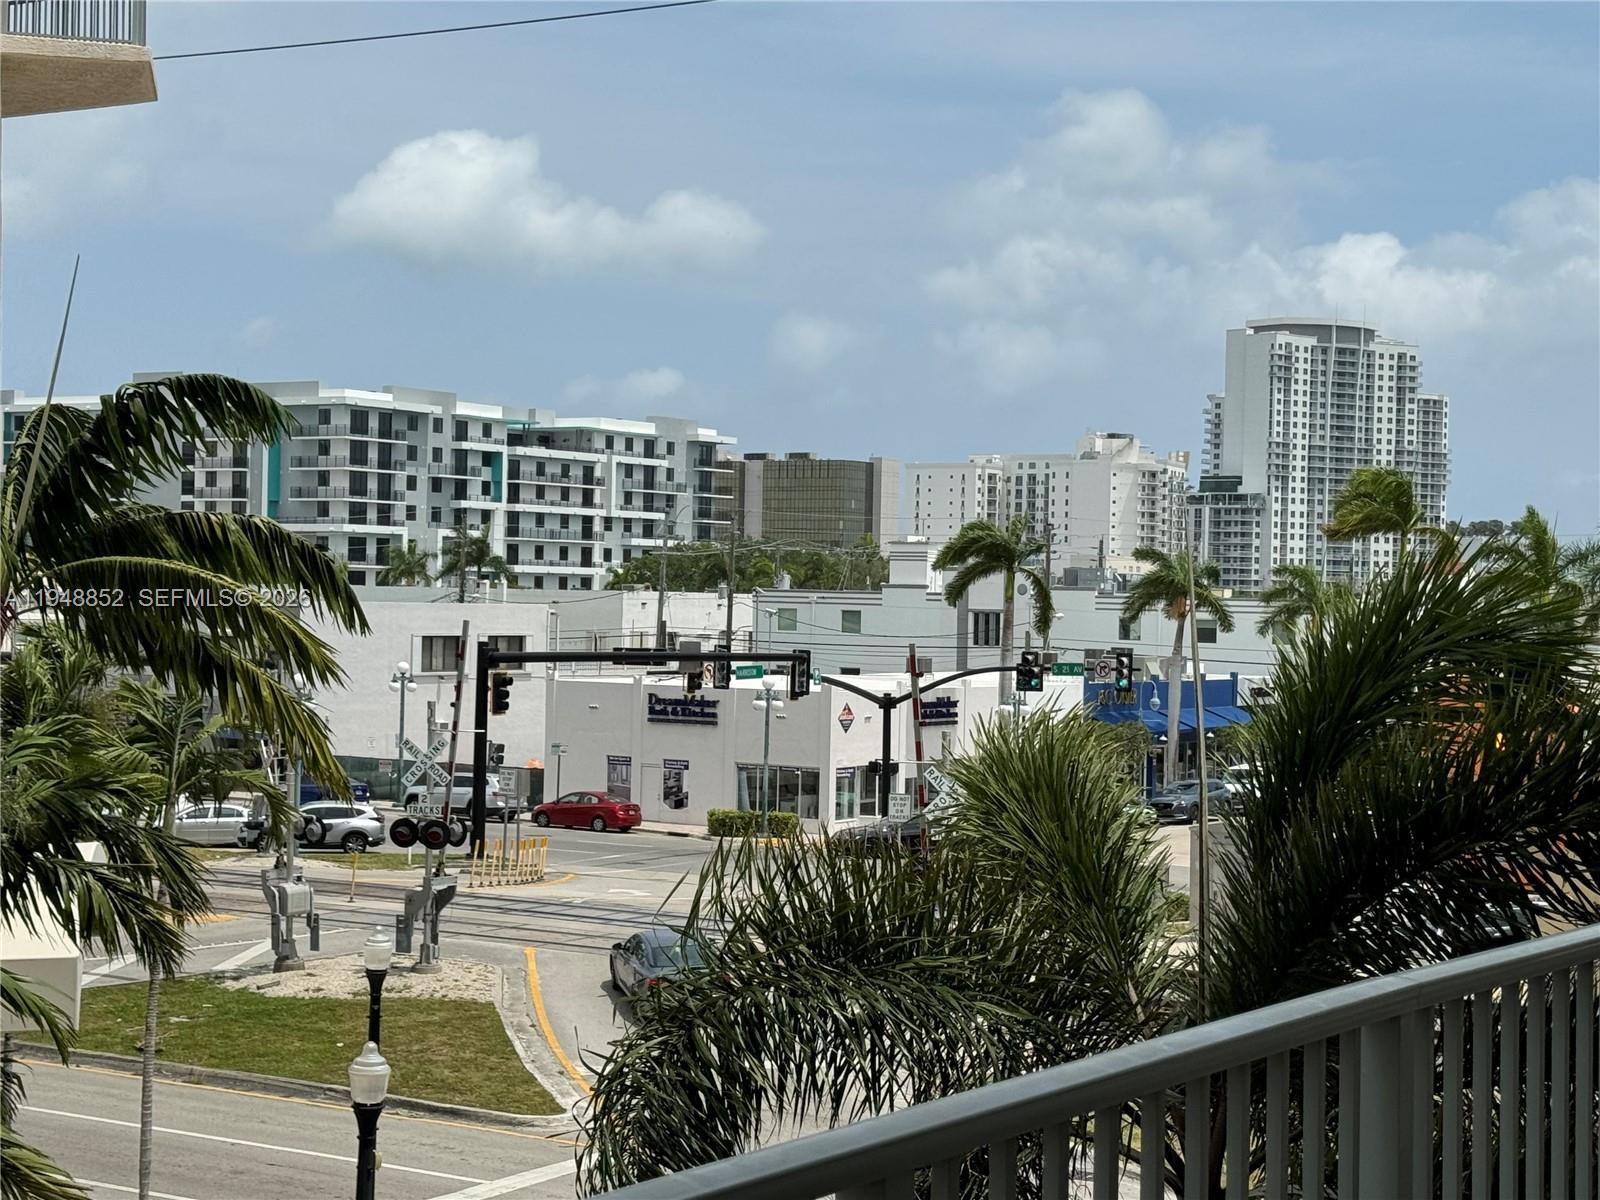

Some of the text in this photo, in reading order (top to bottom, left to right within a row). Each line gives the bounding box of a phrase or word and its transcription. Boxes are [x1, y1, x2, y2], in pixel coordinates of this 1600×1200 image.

[401, 740, 419, 760] RAIL
[428, 764, 448, 785] ROAD
[405, 740, 446, 784] CROSSING
[926, 768, 946, 791] RAIL
[408, 805, 440, 815] TRACKS
[421, 794, 428, 803] 2
